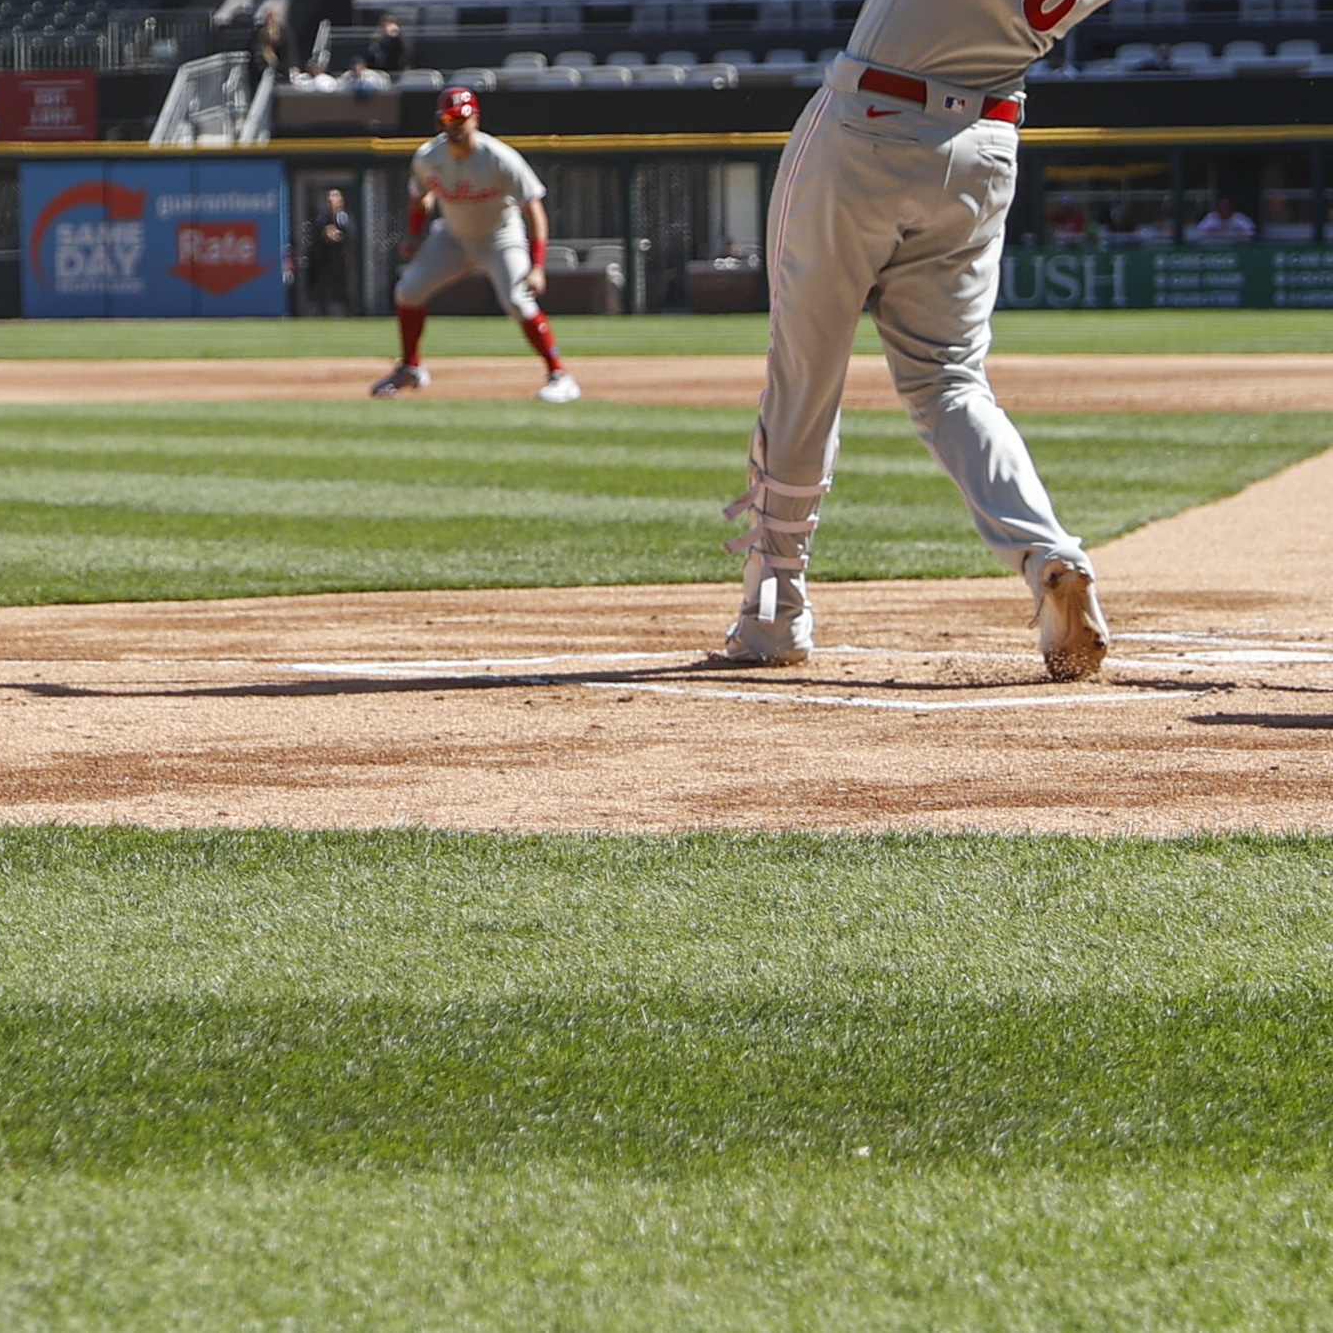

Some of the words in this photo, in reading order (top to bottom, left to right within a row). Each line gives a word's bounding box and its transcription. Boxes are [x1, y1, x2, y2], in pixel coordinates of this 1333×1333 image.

[156, 188, 278, 218] guaranteed
[55, 222, 145, 244] SAME
[177, 227, 257, 265] Rate
[55, 244, 145, 277] DAY
[997, 253, 1130, 309] USH
